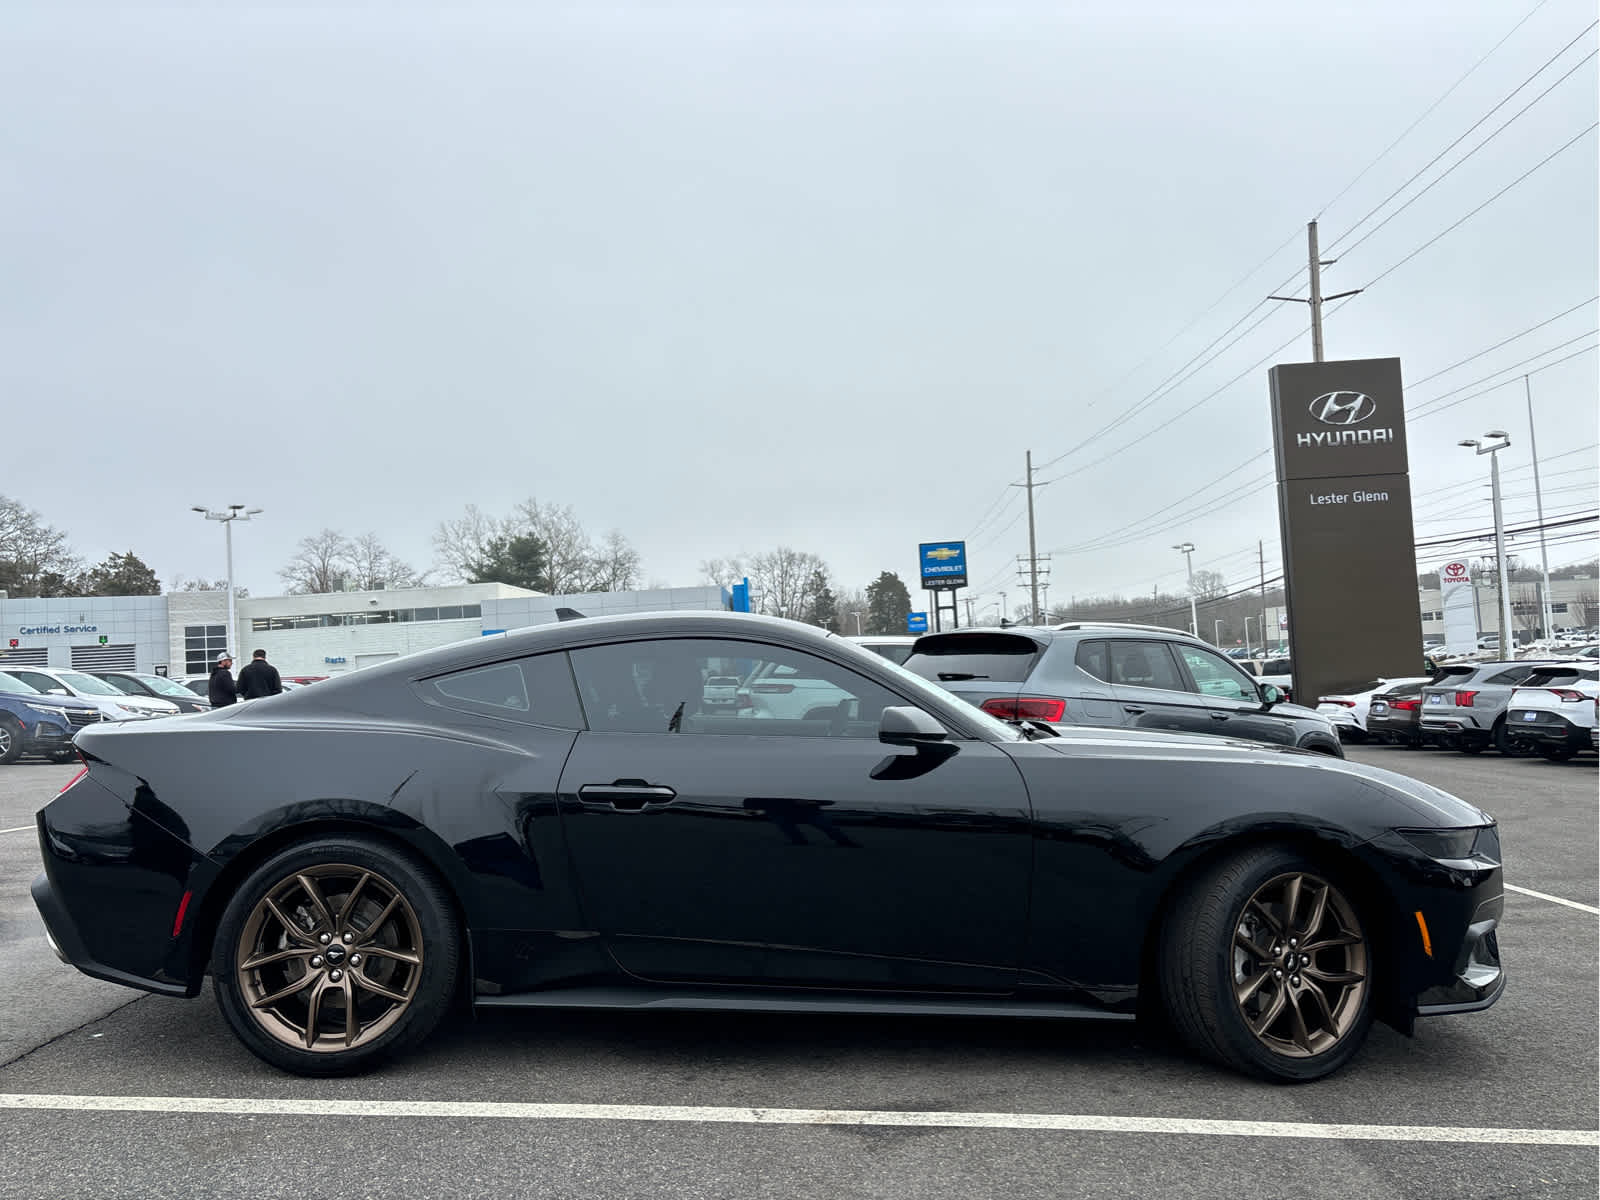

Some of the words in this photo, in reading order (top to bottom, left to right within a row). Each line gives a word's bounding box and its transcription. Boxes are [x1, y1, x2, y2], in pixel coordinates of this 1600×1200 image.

[1296, 428, 1393, 448] HYUNDAI
[1310, 492, 1349, 505] Lester
[1352, 490, 1389, 503] Glenn
[924, 564, 963, 574] CHEVROLET
[1443, 576, 1471, 584] TOYOTA
[19, 625, 60, 635] Certified
[63, 624, 98, 634] Service
